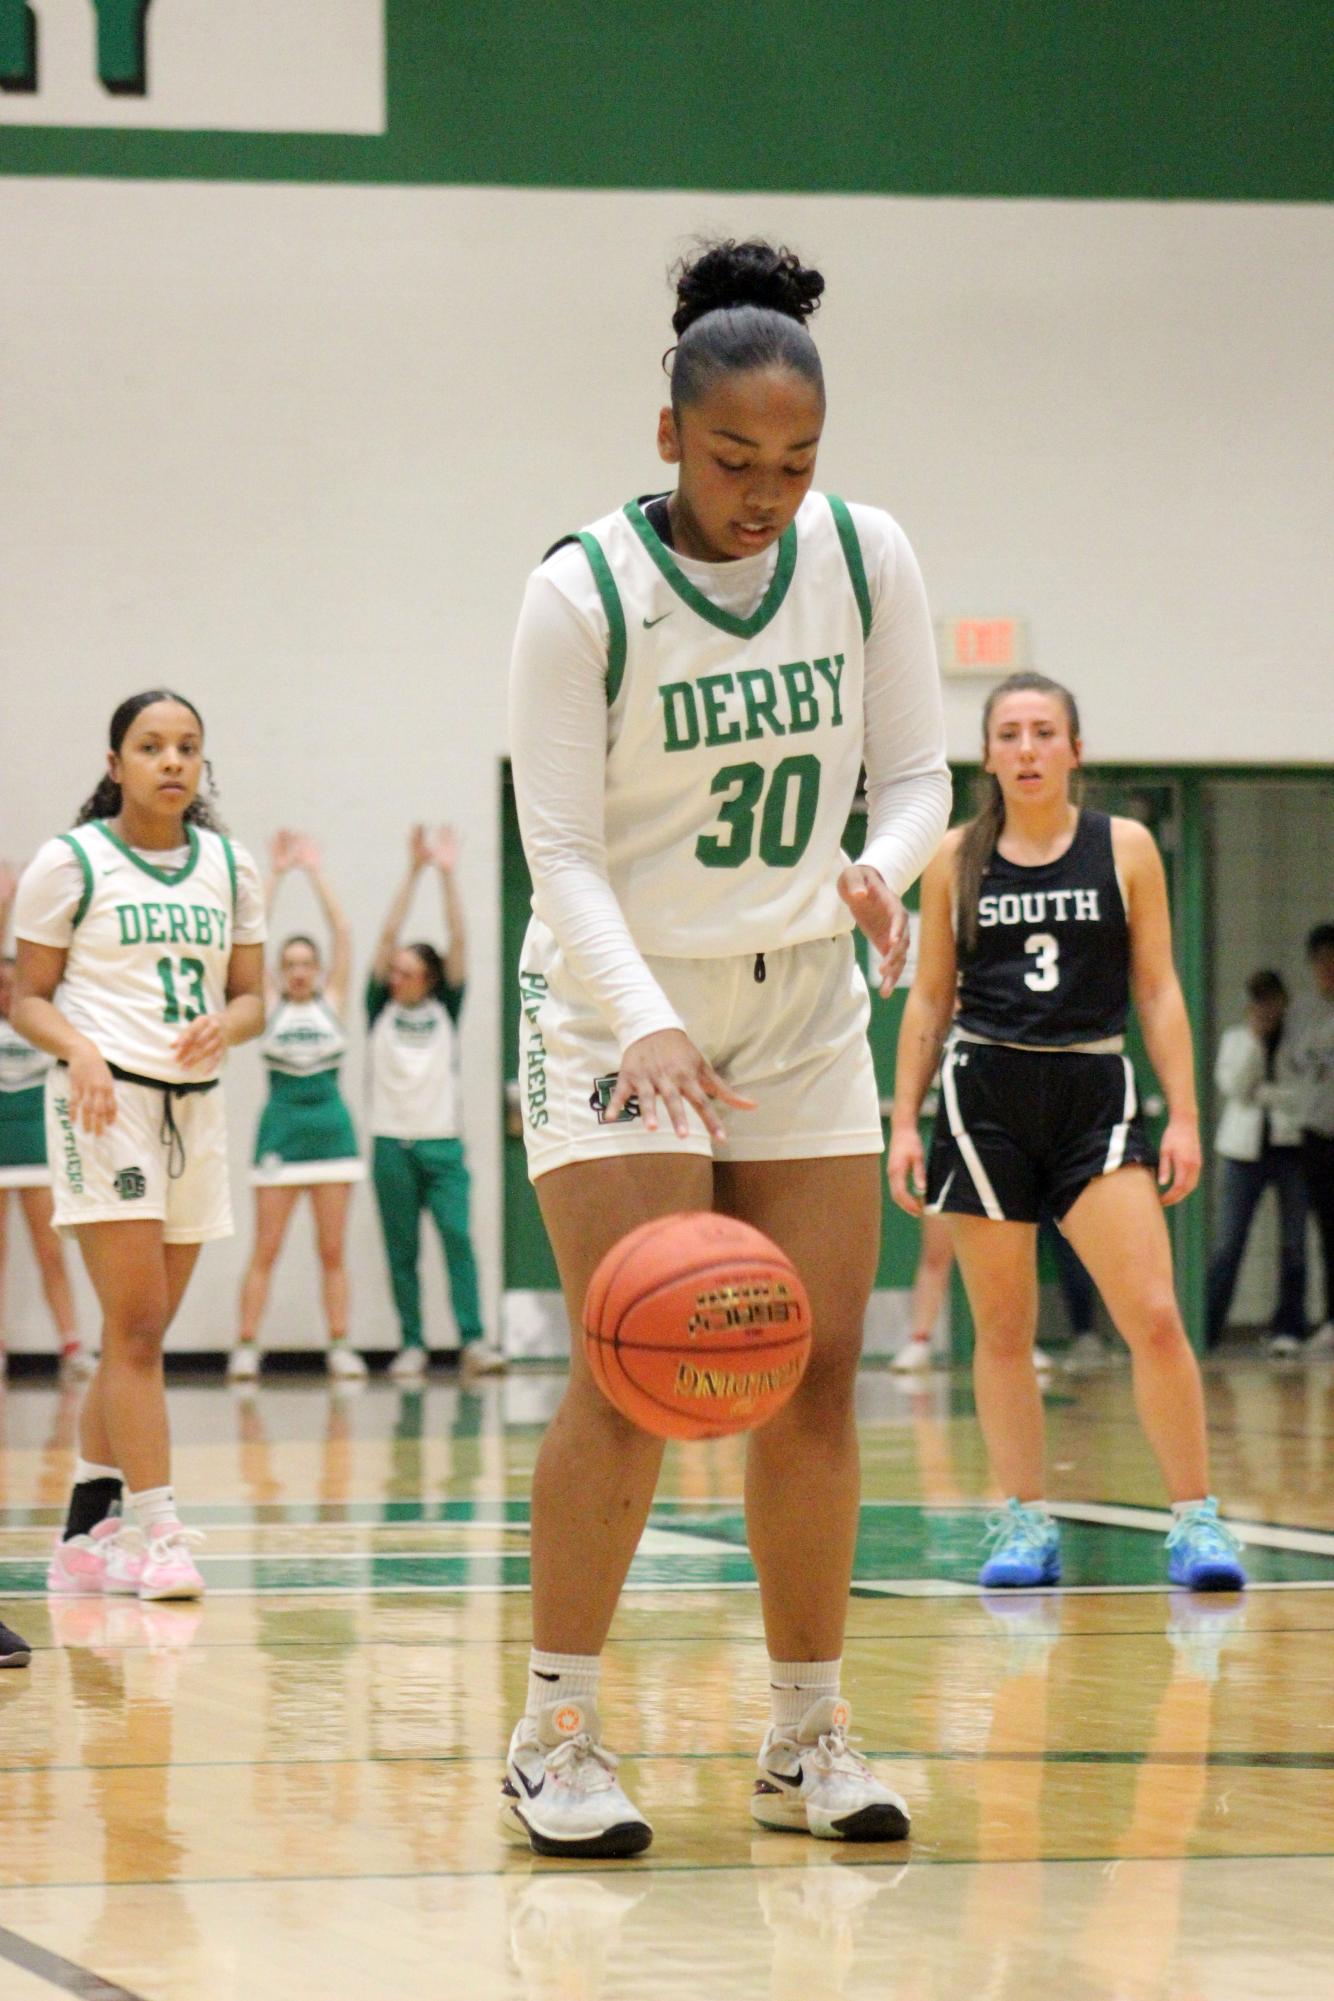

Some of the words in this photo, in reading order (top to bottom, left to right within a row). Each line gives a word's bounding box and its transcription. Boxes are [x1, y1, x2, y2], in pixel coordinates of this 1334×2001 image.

[657, 653, 845, 753] DERBY
[694, 753, 822, 869] 30
[115, 903, 227, 951] DERBY
[978, 889, 1100, 927] SOUTH
[157, 957, 207, 1023] 13
[1024, 933, 1059, 991] 3
